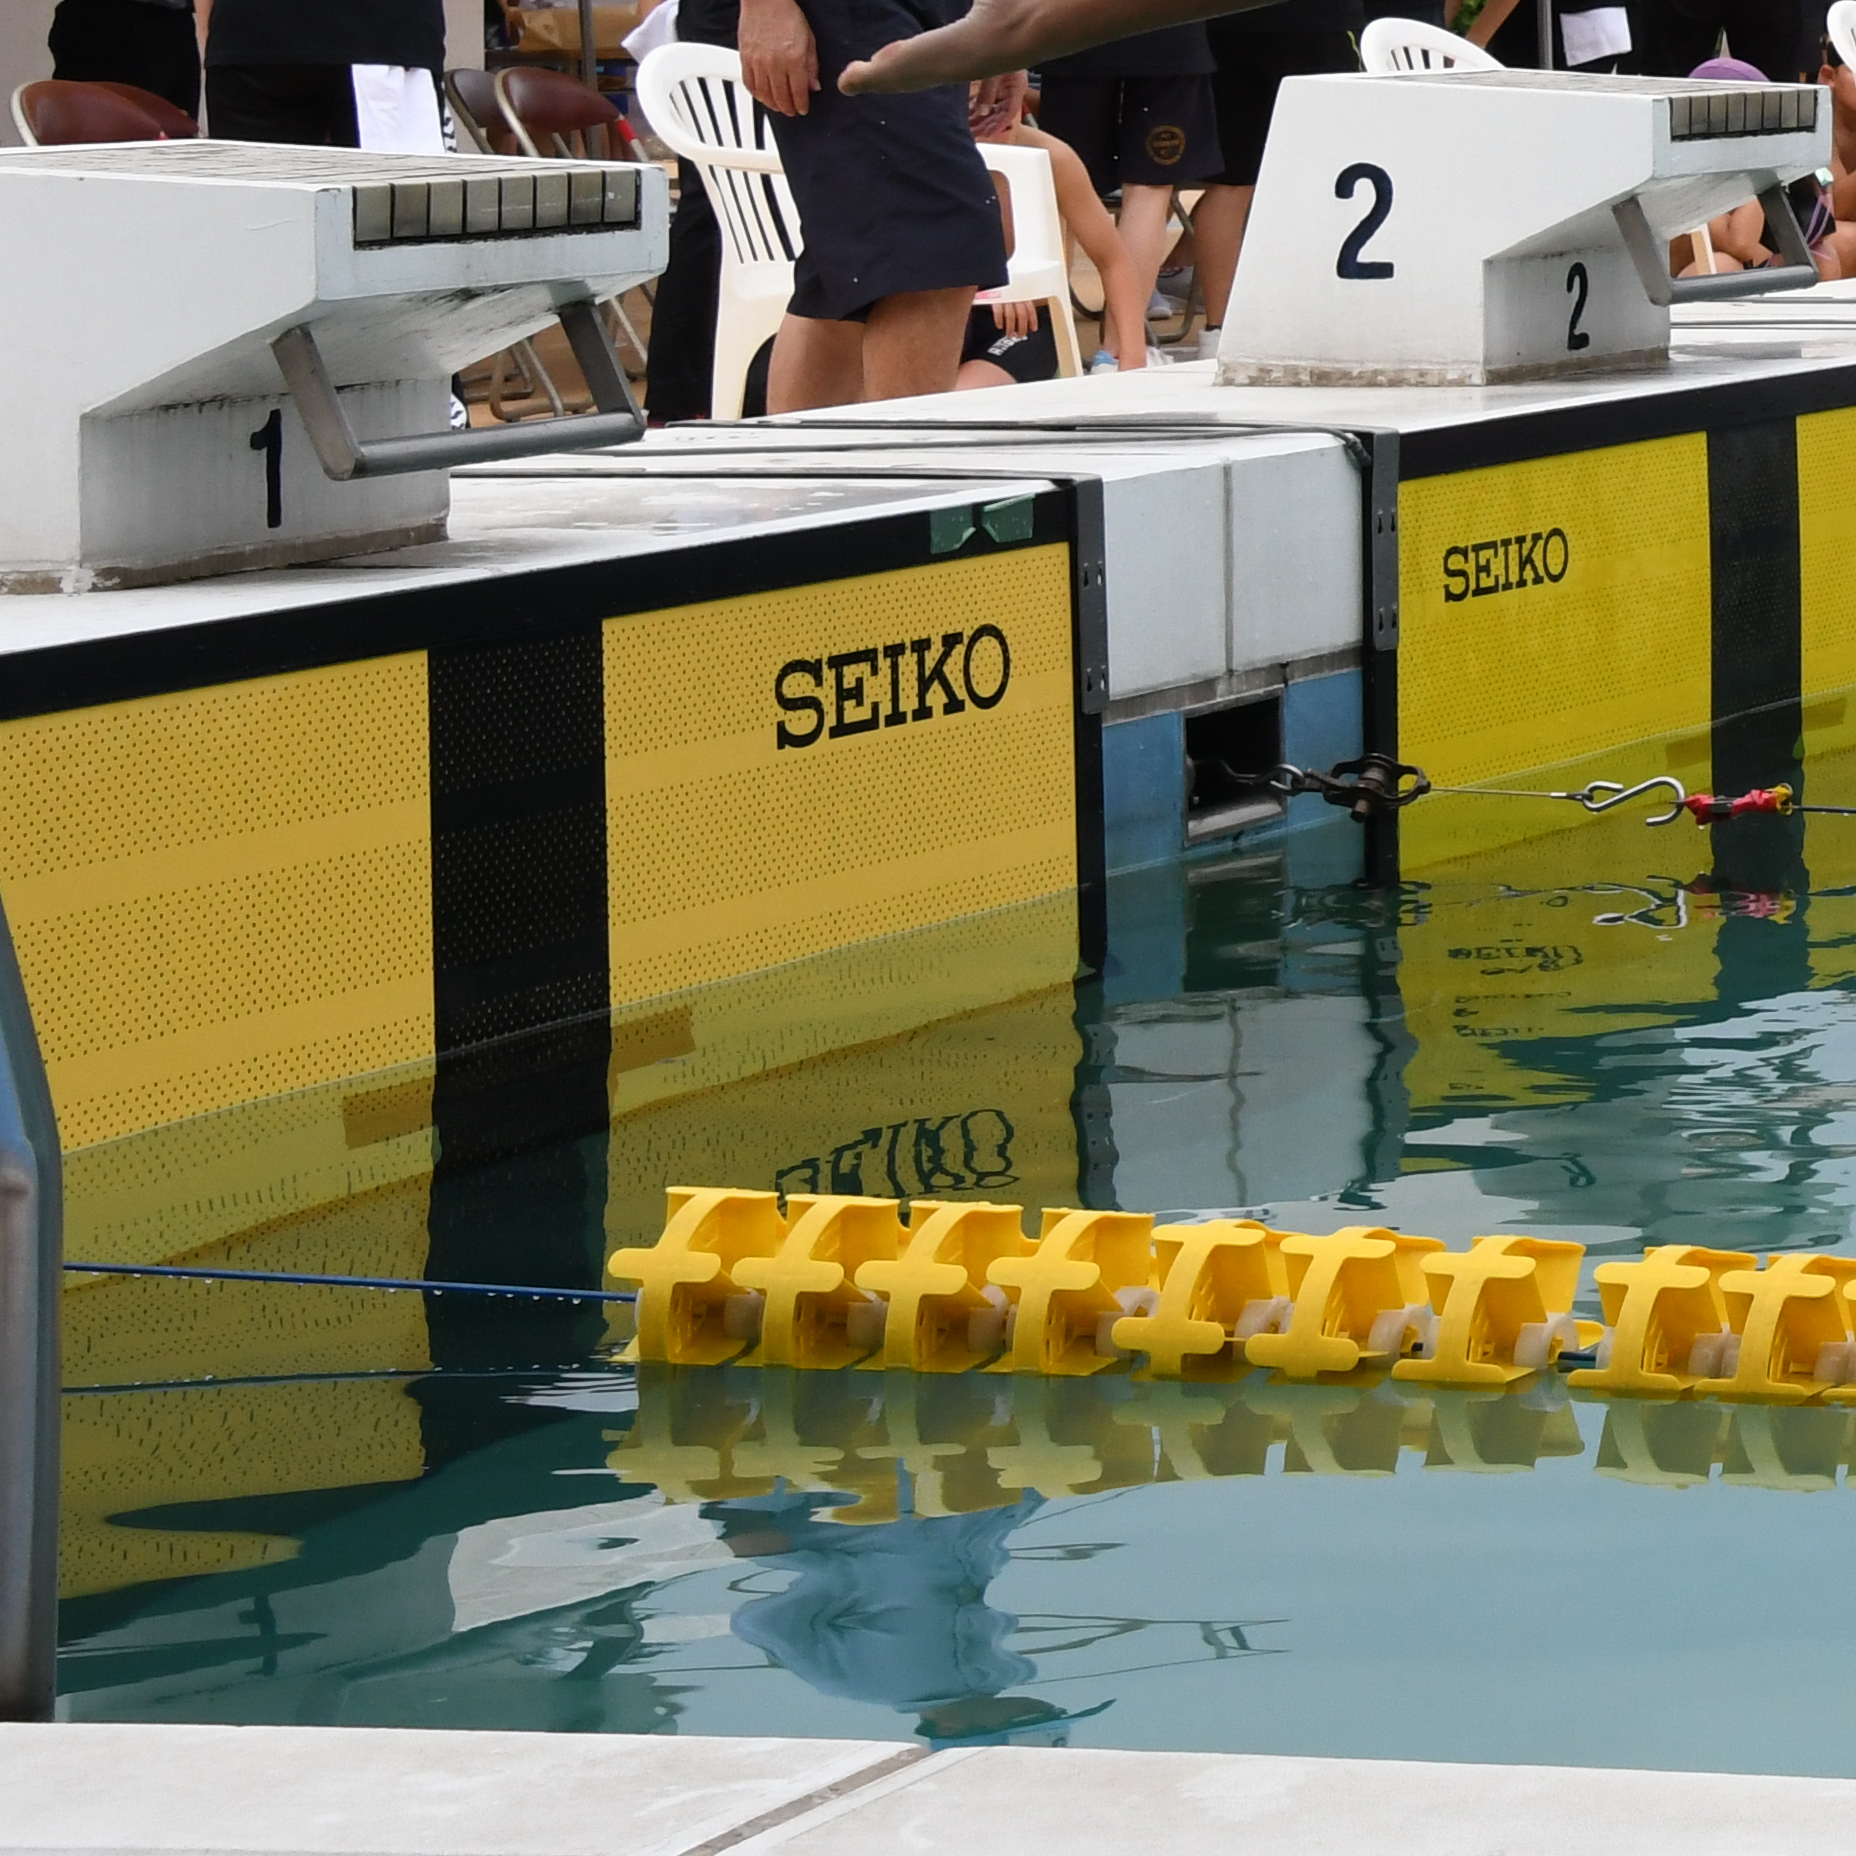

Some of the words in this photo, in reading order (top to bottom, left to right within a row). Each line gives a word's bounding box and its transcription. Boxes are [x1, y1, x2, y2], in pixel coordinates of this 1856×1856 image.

[1334, 162, 1394, 280] 2
[1566, 262, 1591, 351] 2
[250, 409, 282, 529] 1
[1442, 527, 1569, 604] SEIKO
[775, 623, 1010, 751] SEIKO
